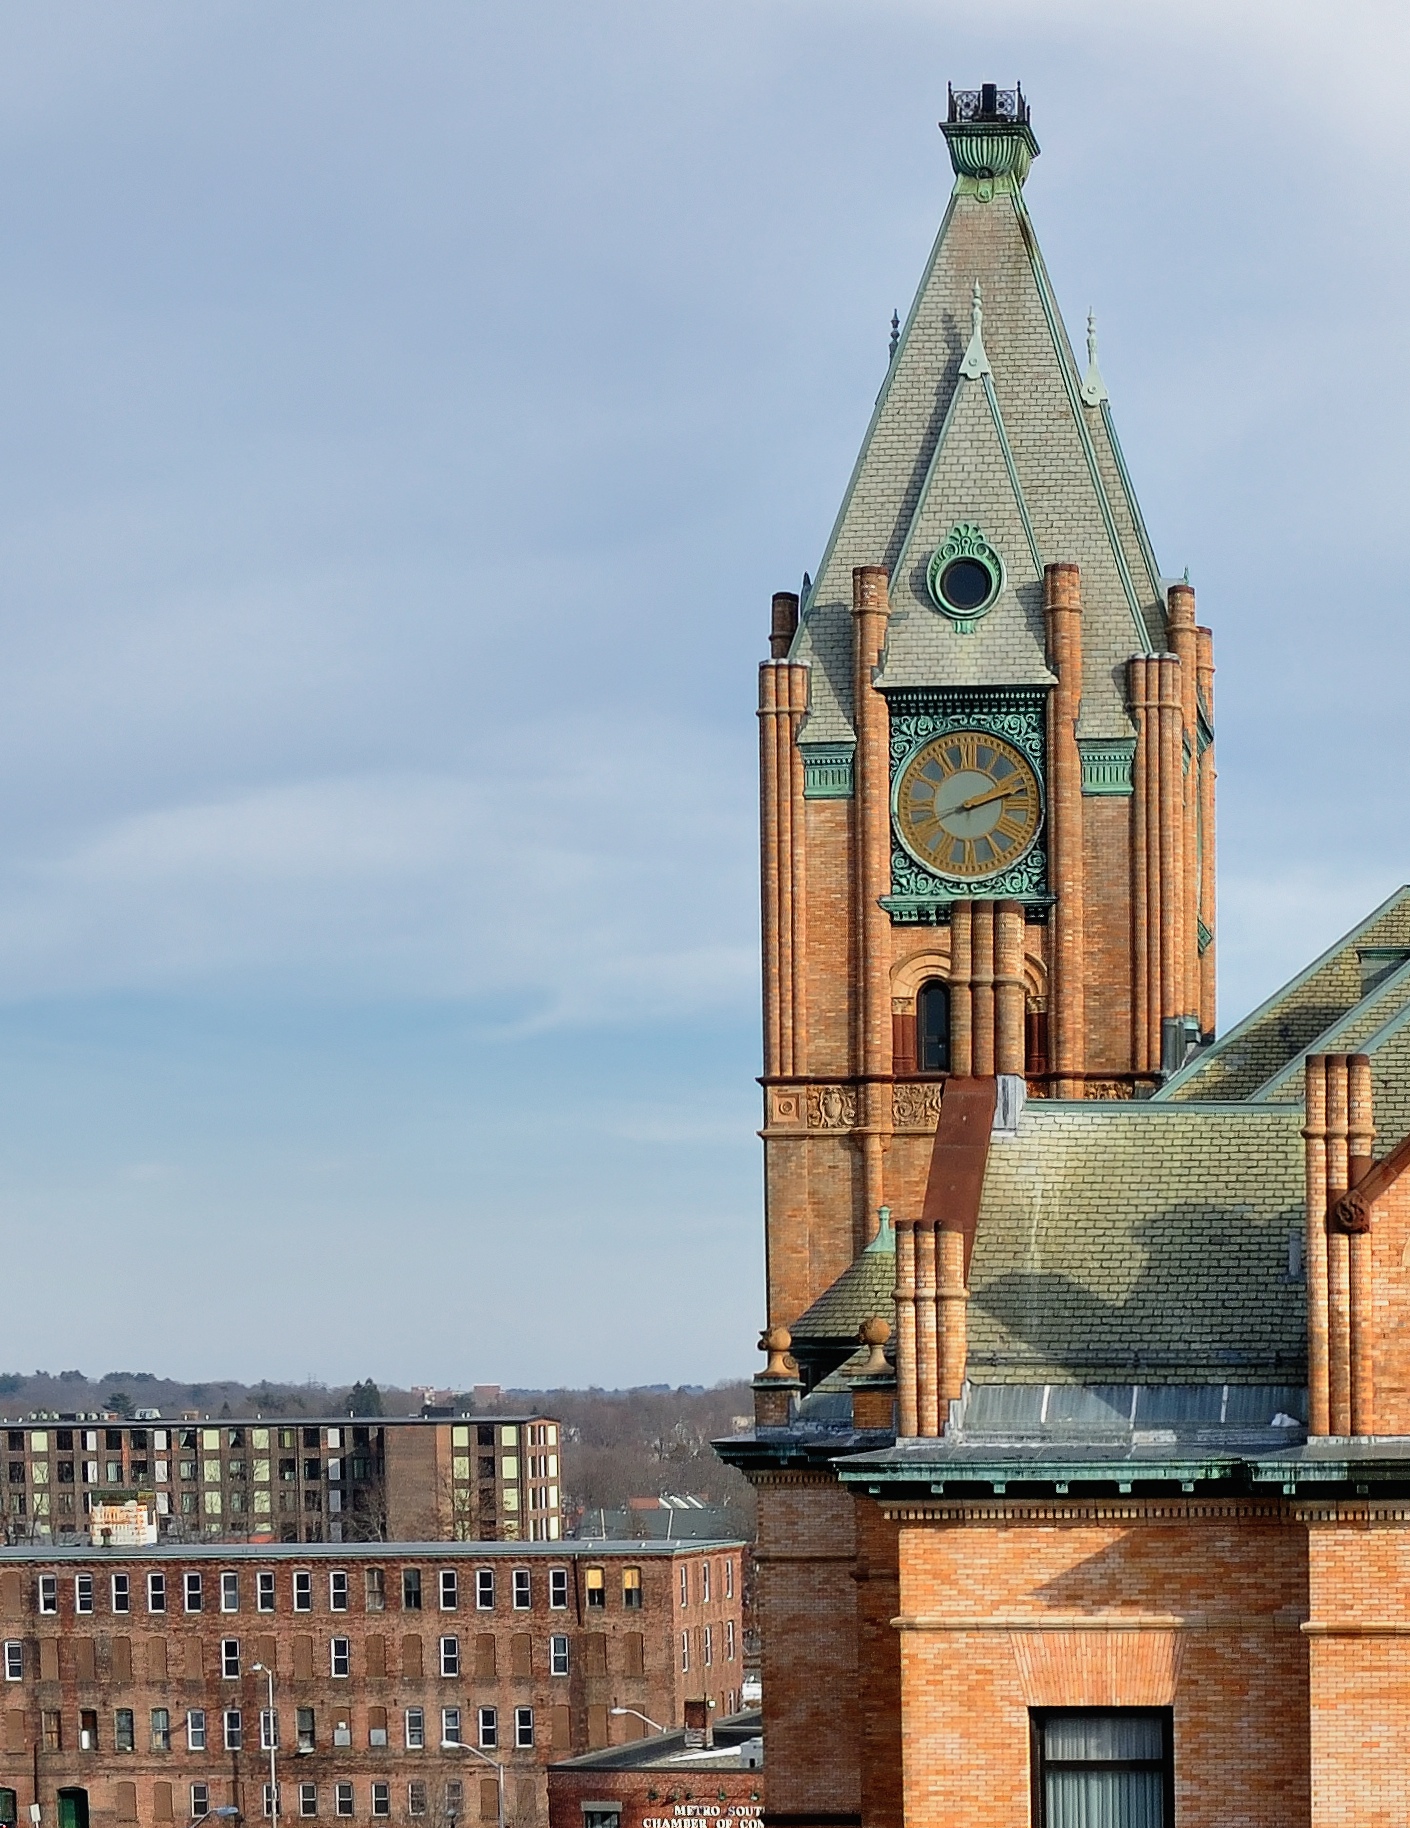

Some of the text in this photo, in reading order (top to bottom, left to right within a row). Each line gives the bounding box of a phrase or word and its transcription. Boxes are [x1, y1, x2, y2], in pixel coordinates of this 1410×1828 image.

[674, 1805, 765, 1816] METRO SOUT
[642, 1818, 707, 1828] CHAMBER
